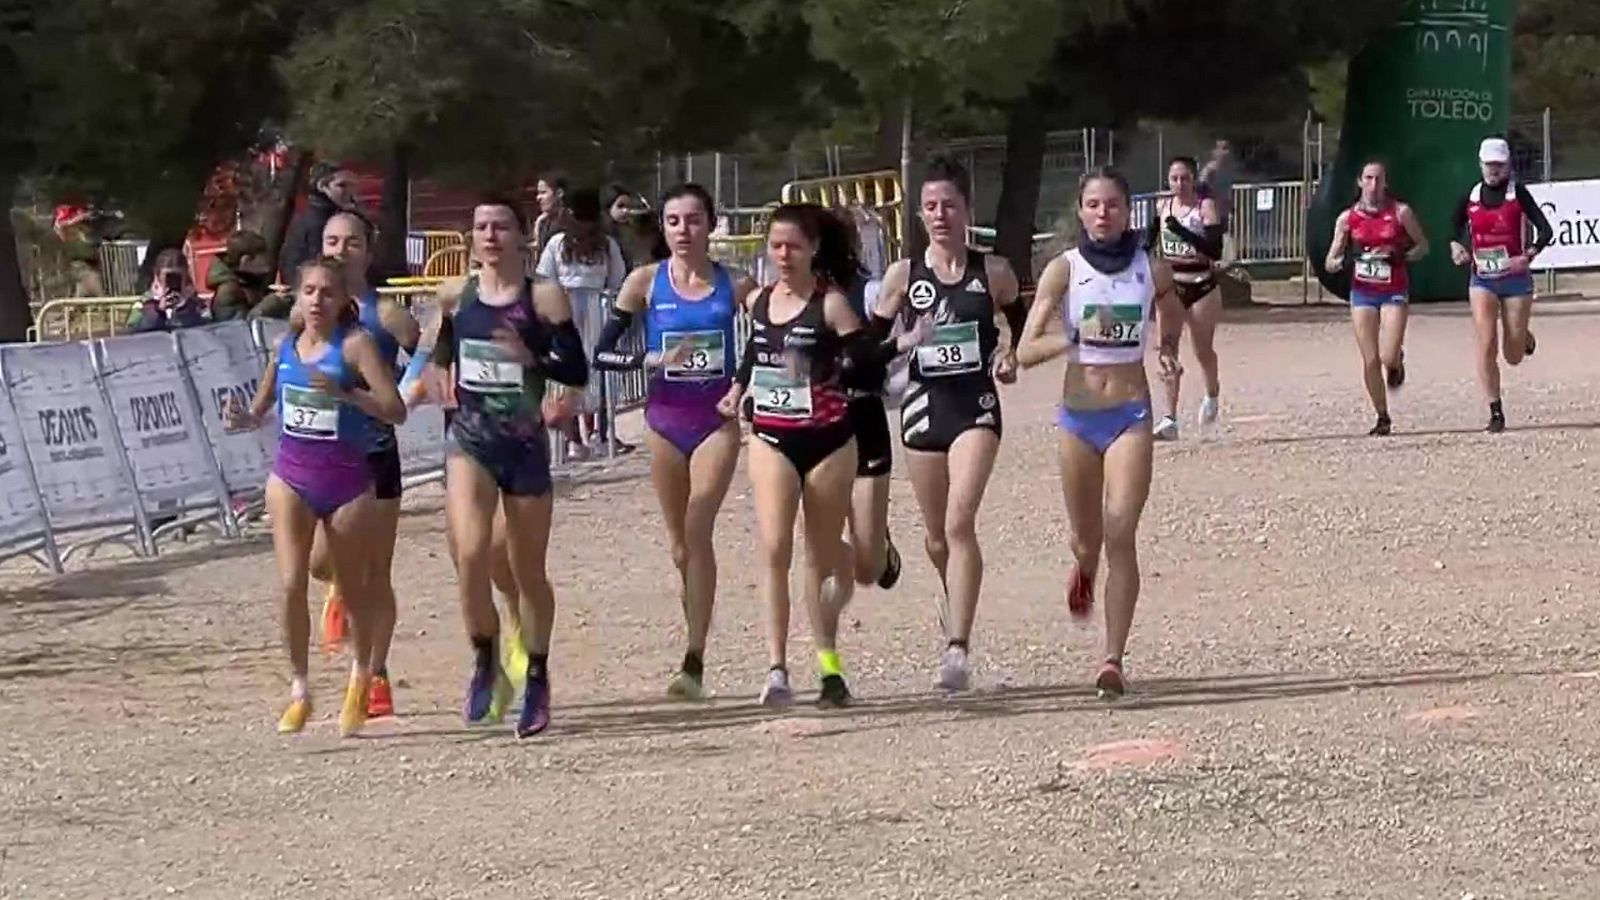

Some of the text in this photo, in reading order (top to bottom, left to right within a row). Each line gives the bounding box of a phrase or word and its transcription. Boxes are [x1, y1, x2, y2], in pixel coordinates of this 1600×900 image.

[1408, 99, 1493, 121] TOLEDO
[937, 345, 962, 364] 38
[769, 389, 792, 407] 32
[294, 408, 318, 427] 37
